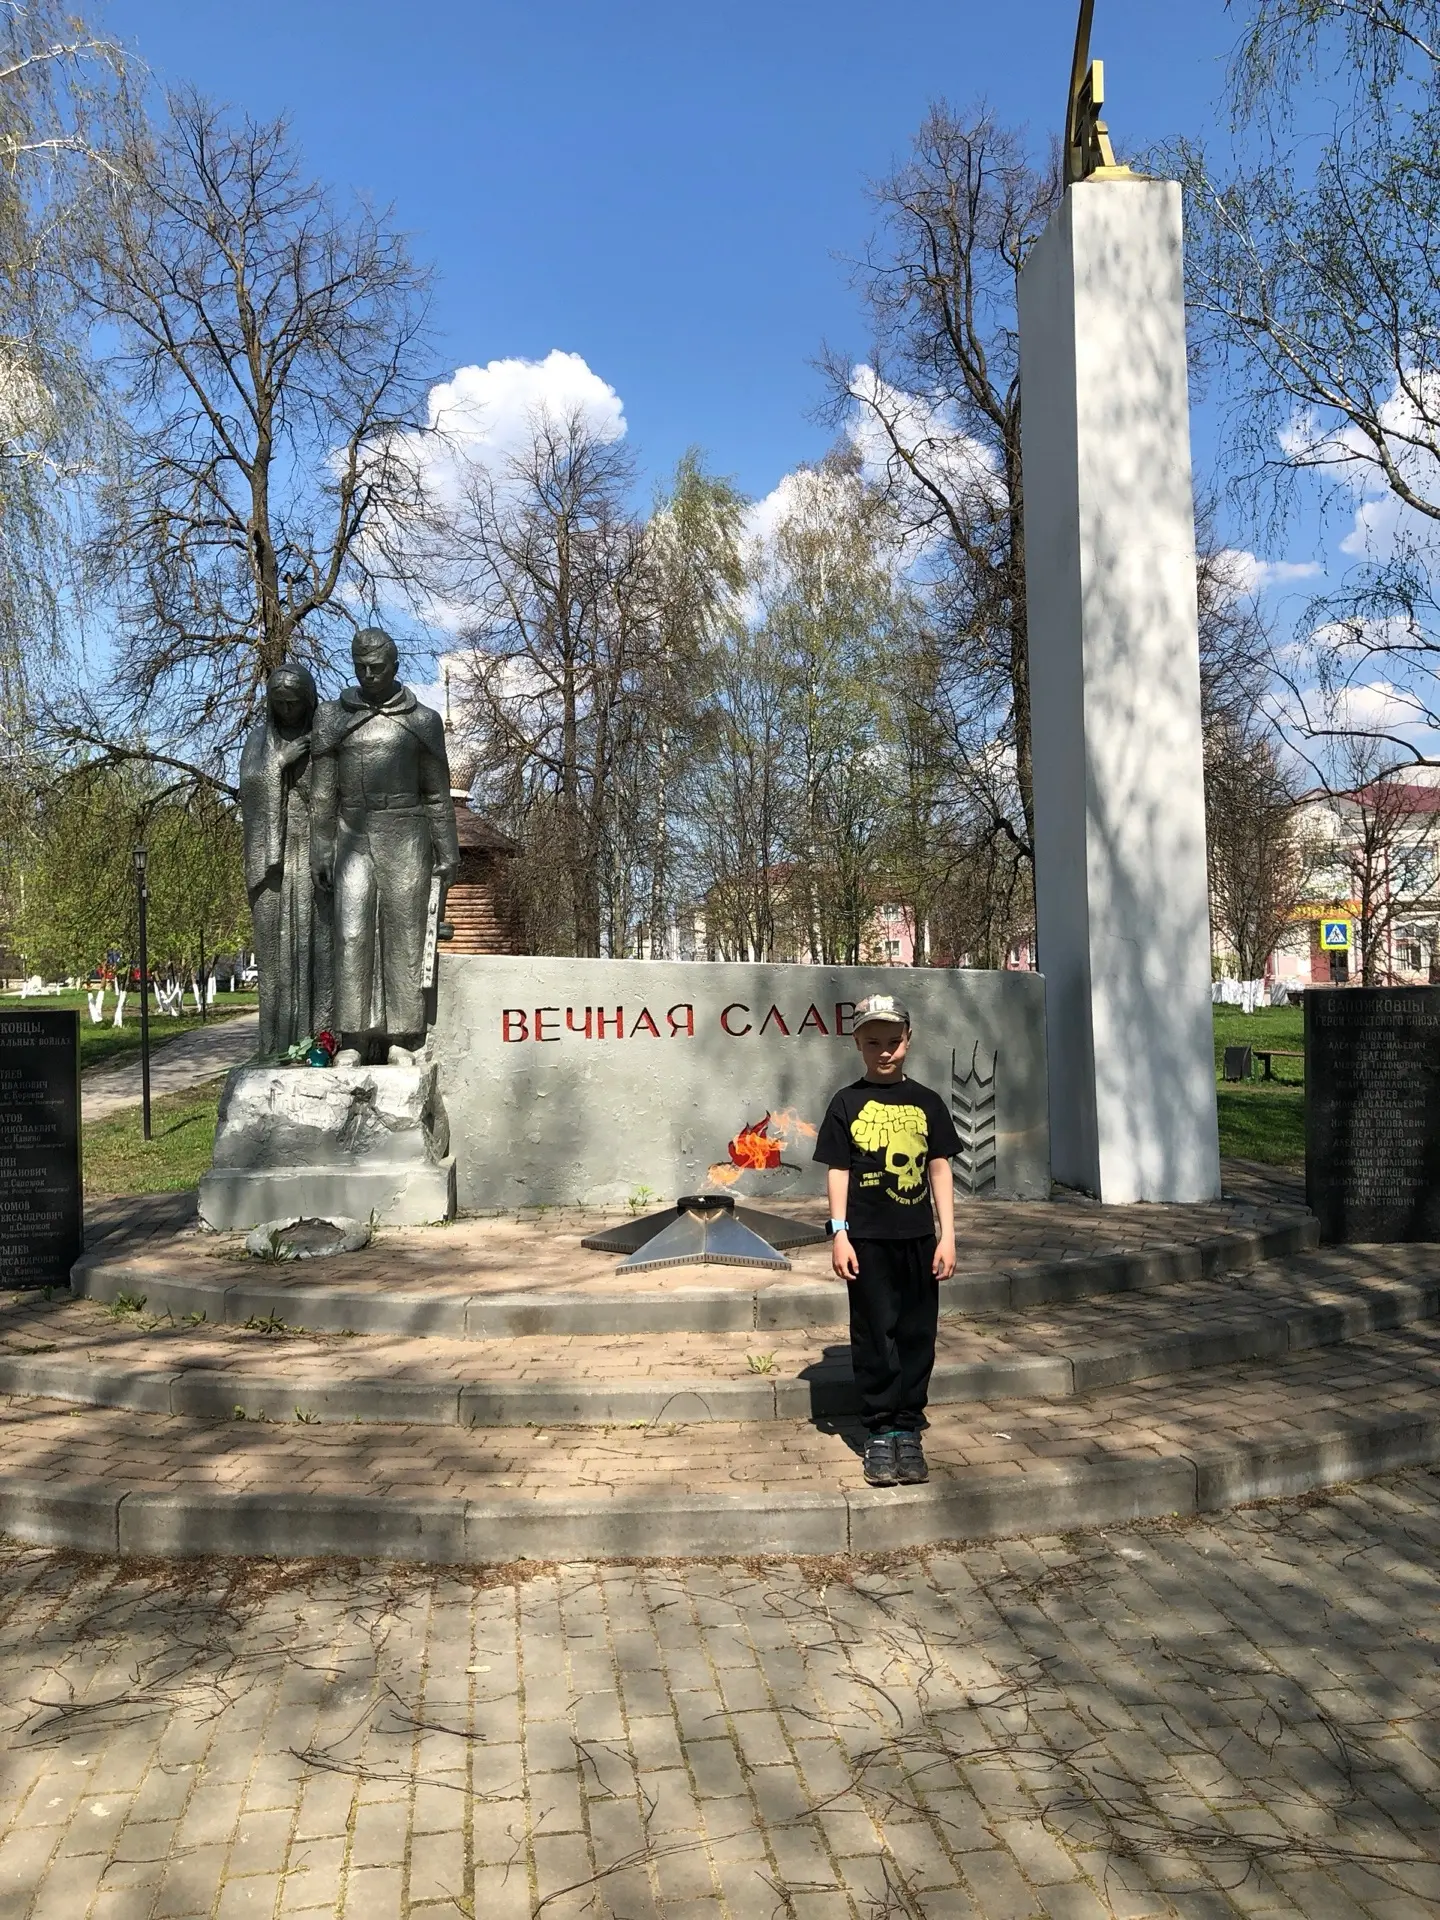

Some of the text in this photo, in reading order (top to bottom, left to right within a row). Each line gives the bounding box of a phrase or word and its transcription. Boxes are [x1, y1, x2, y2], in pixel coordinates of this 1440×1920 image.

[1328, 999, 1425, 1013] САПОЖКОВЦЫ
[503, 1003, 694, 1042] ВЕЧНАЯ
[720, 1003, 856, 1037] СЛАВ
[860, 1180, 880, 1188] LESS
